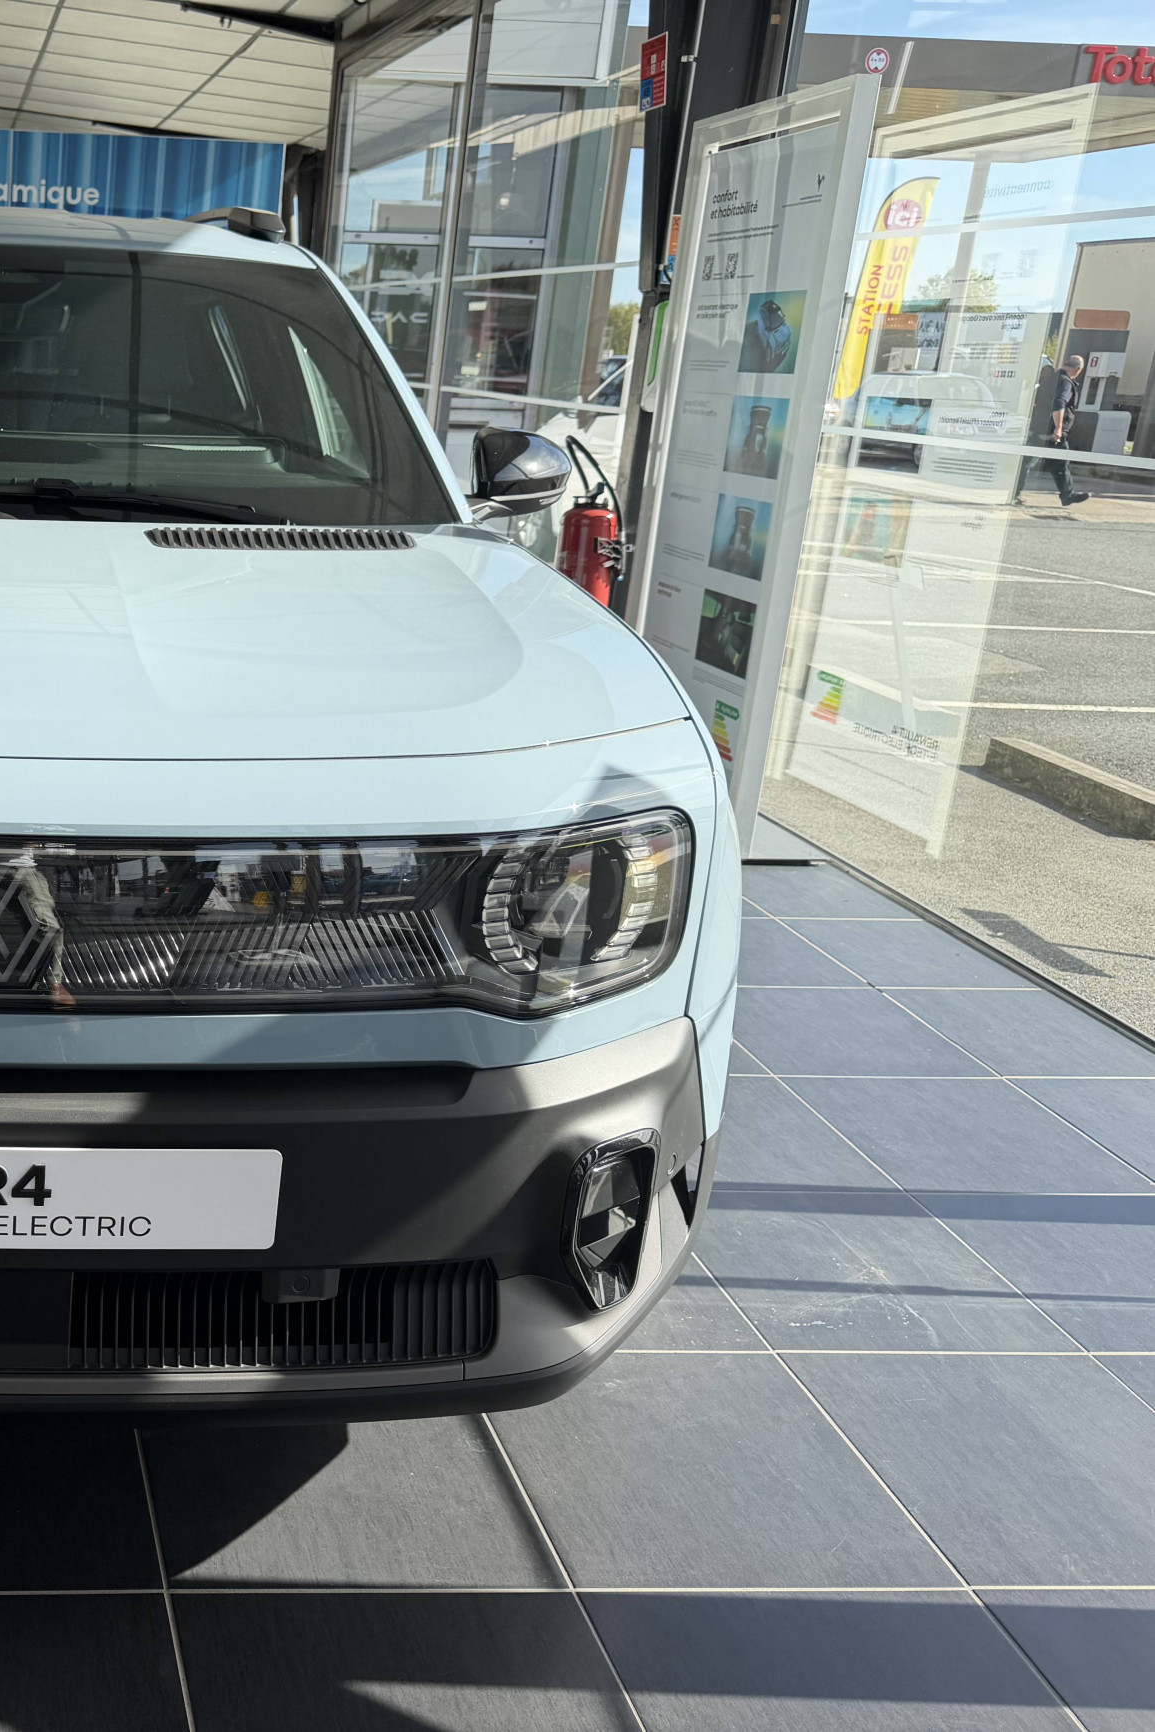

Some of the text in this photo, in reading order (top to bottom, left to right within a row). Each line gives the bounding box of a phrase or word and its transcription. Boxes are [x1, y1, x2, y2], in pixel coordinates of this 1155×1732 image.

[1085, 45, 1155, 85] Tot
[712, 188, 739, 204] confort
[718, 200, 758, 218] habitabilité
[887, 205, 919, 227] ici
[857, 264, 883, 335] STATION
